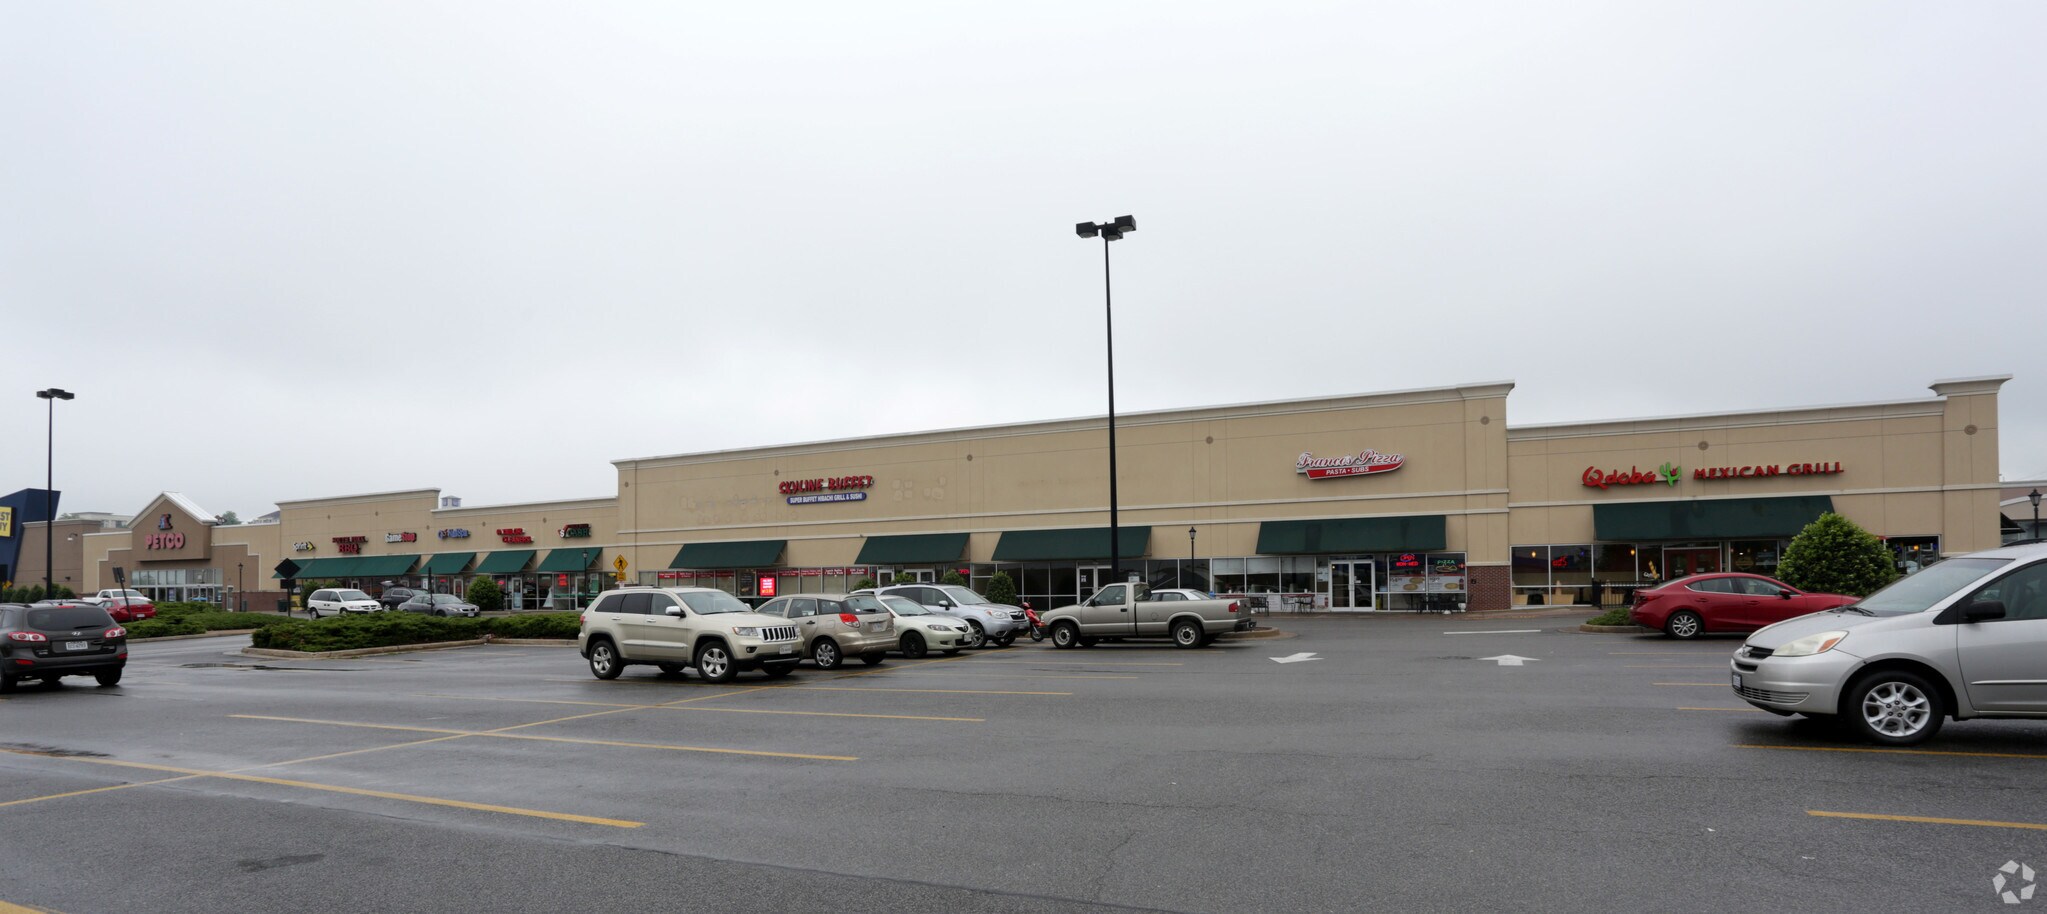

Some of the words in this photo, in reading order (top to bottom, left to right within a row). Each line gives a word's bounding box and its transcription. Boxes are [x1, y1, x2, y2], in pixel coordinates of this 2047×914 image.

[1356, 448, 1402, 465] Pizza
[1351, 466, 1369, 474] SUBS
[1582, 465, 1657, 490] Qdoba
[1693, 464, 1780, 480] MEXICAN
[1787, 461, 1841, 476] GRILL
[779, 479, 824, 494] SKYLINE
[827, 475, 873, 490] BUFFET
[144, 532, 186, 550] PETCO
[385, 532, 417, 543] GameStop
[338, 543, 362, 555] BBQ
